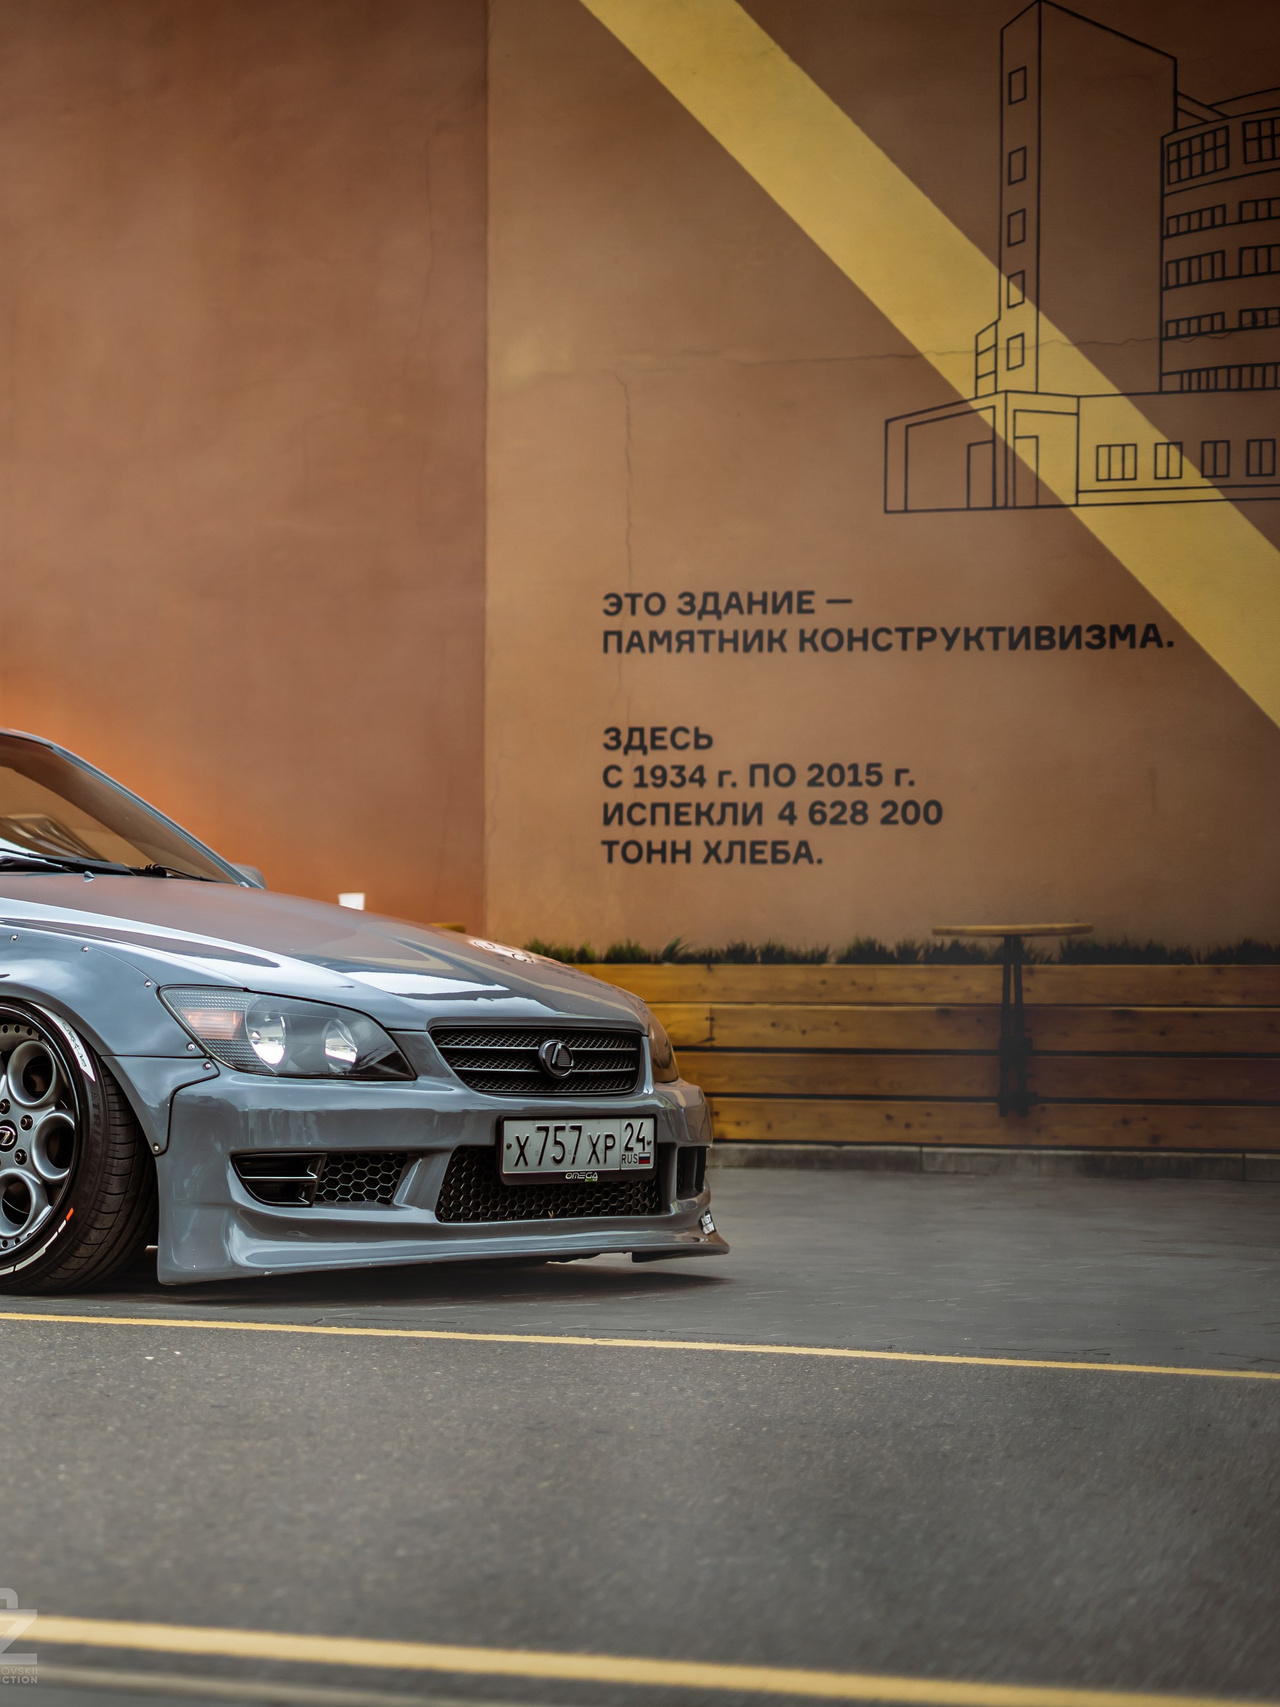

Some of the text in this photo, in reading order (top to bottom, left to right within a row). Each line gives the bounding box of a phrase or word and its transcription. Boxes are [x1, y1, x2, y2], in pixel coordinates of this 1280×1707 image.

[602, 591, 667, 617] ЭТО
[676, 590, 816, 622] ЗДАНИЕ
[602, 622, 1175, 655] ПАМЯТНИК КОНСТРУКТИВИЗМА.
[602, 726, 714, 757] ЗДЕСЬ
[602, 762, 915, 789] С 1934 г. ПО 2015 г.
[602, 799, 944, 827] ИСПЕКЛИ 4 628 200
[600, 839, 823, 865] ТОНН ХЛЕБА.
[623, 1121, 646, 1152] 24
[621, 1153, 638, 1165] RUS
